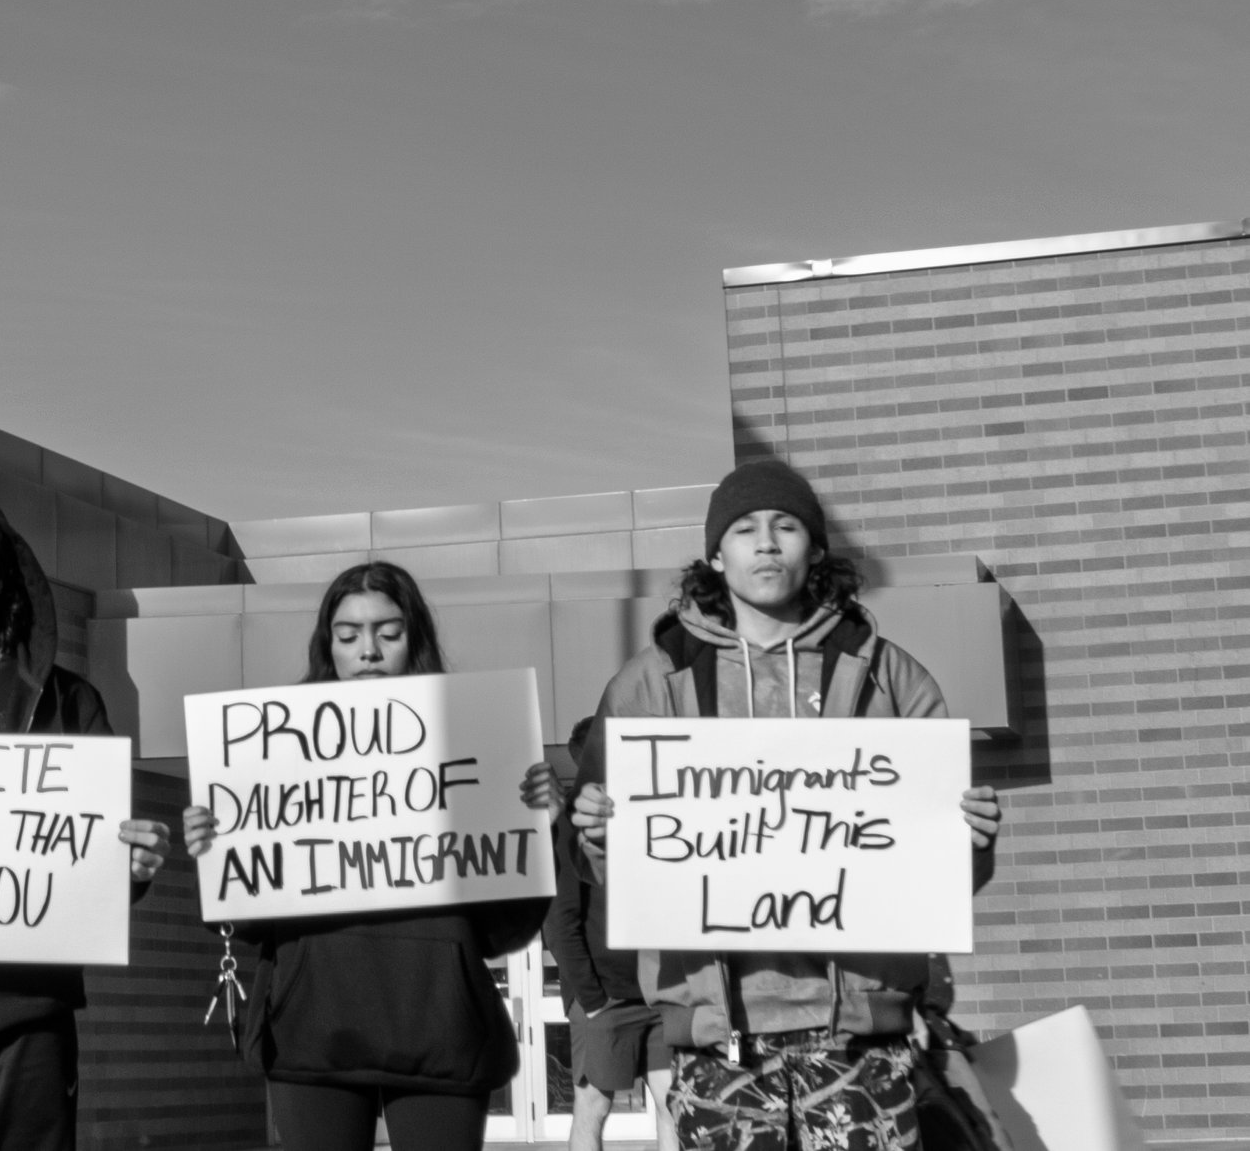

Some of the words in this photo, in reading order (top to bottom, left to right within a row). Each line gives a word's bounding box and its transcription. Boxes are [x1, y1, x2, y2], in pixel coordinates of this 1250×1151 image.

[222, 698, 426, 767] PROUD
[208, 769, 396, 835] DAUGHTER
[404, 757, 480, 812] OF
[620, 734, 899, 830] Immigrants
[10, 809, 104, 866] THAT
[218, 841, 283, 901] AN
[294, 828, 537, 895] IMMIGRANT
[646, 807, 774, 862] Built
[791, 808, 895, 853] This
[702, 868, 845, 934] Land
